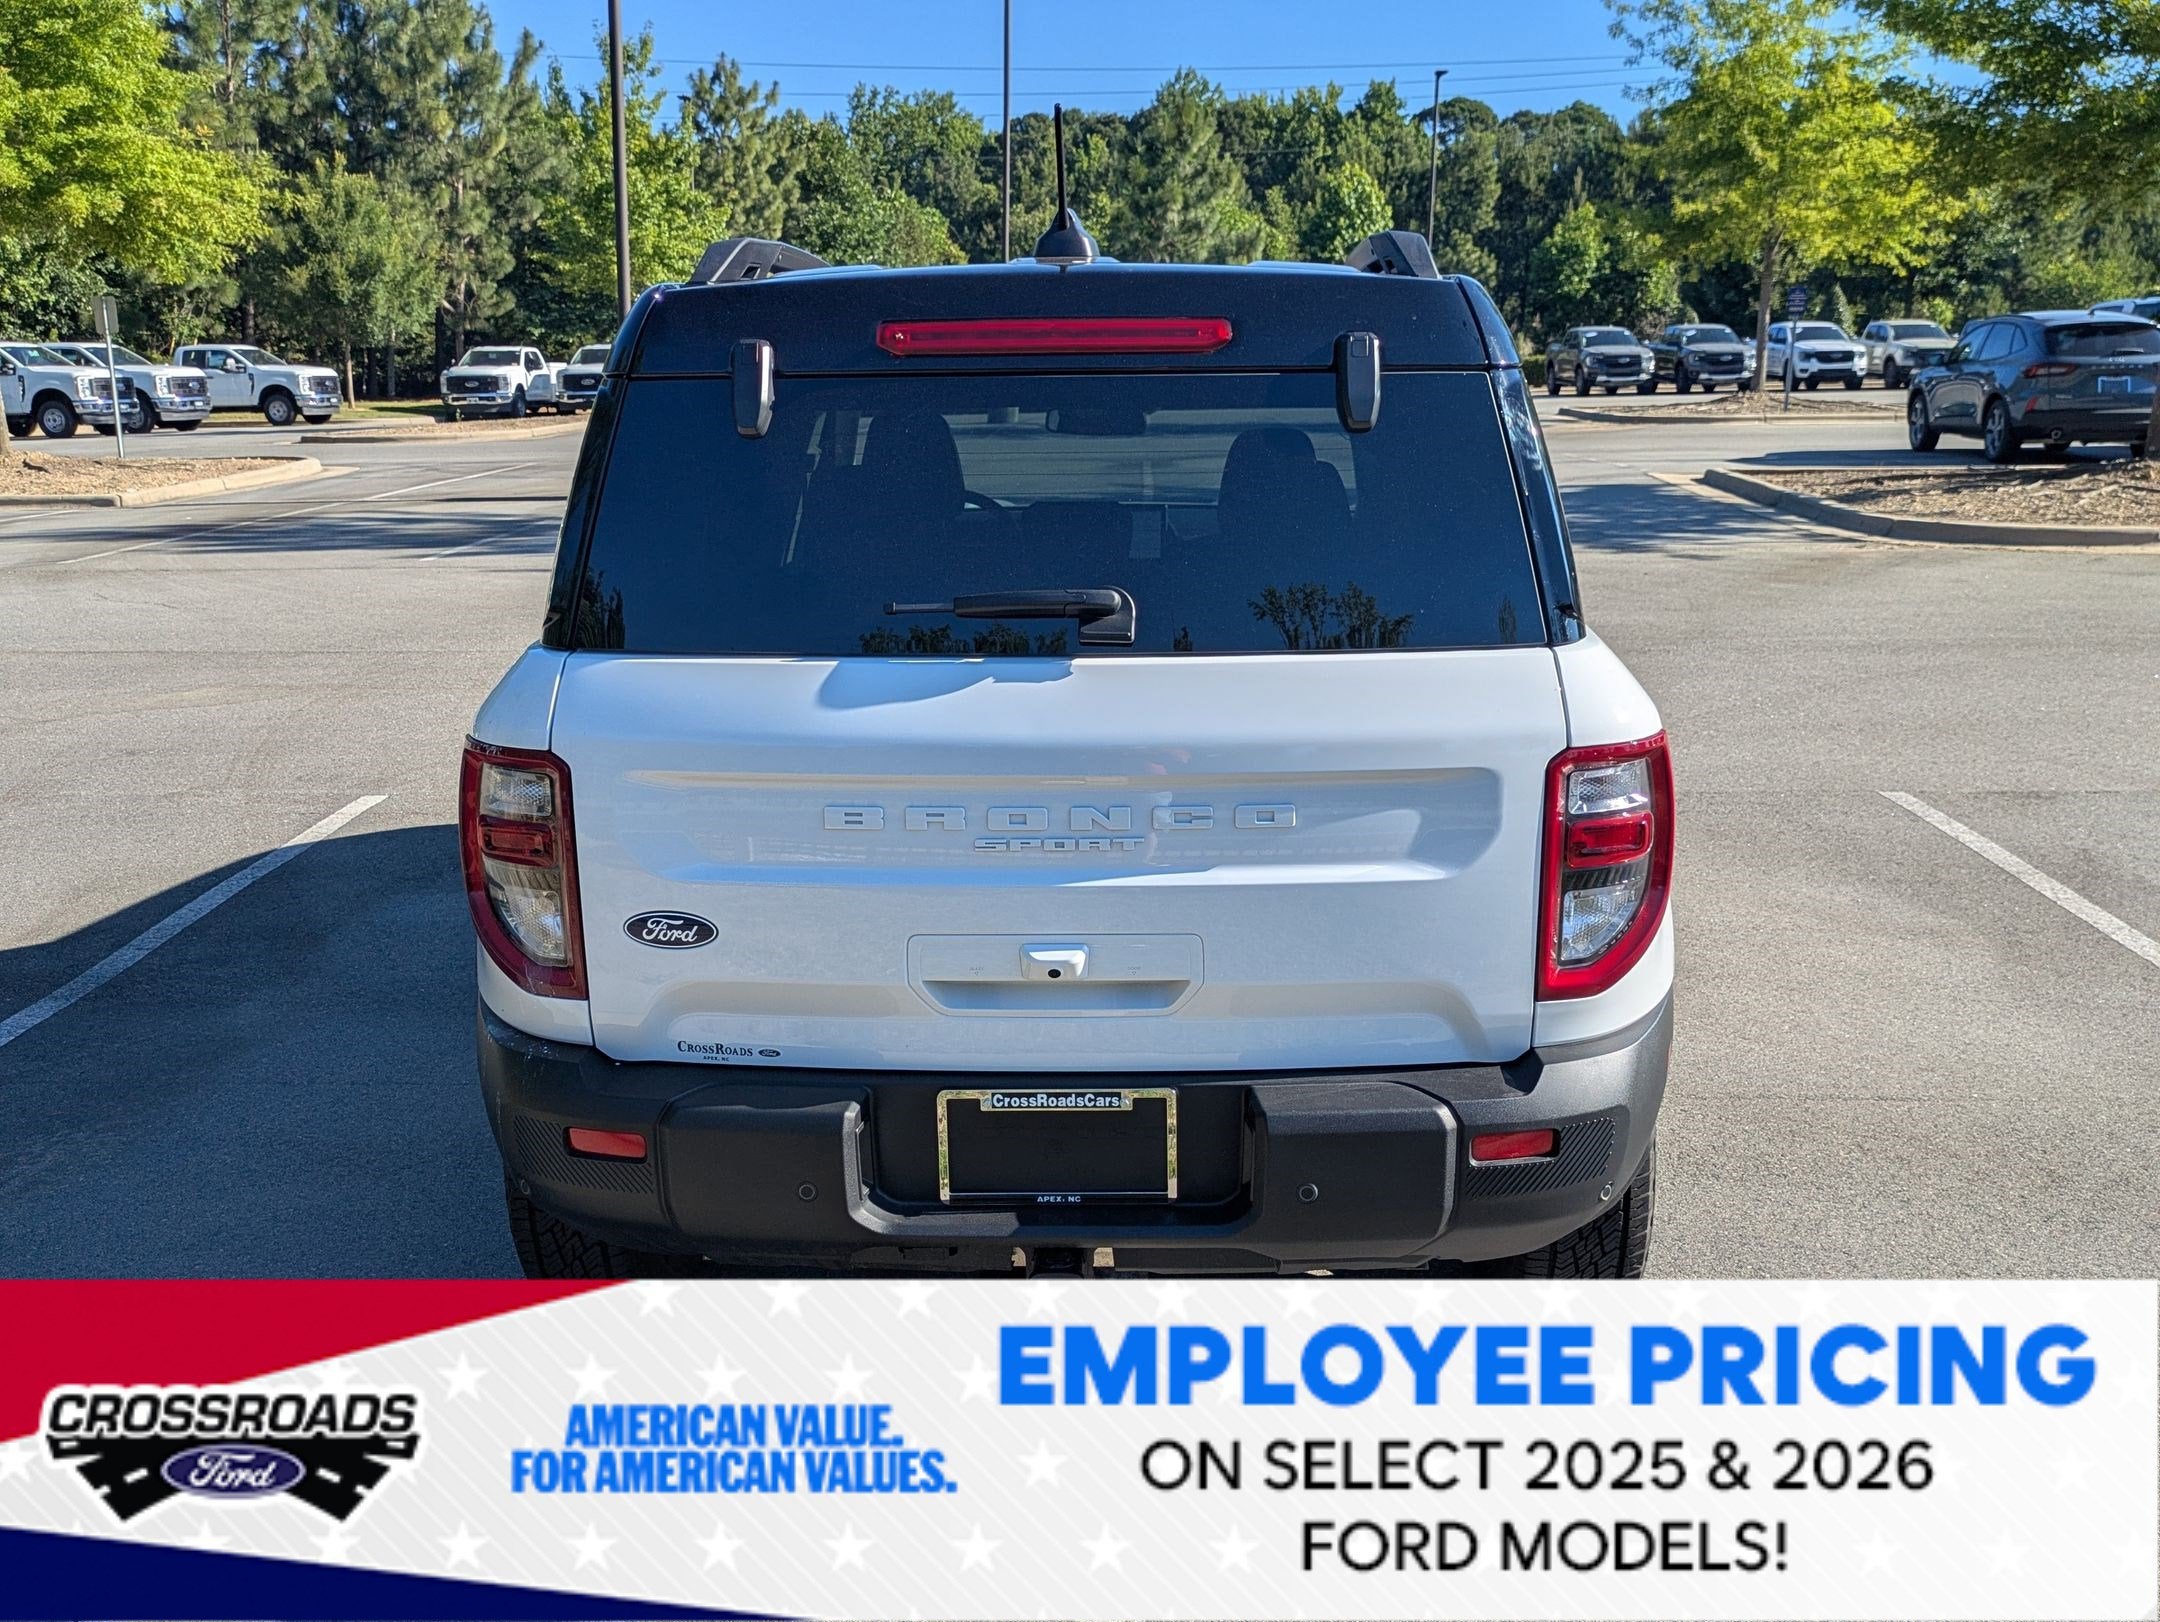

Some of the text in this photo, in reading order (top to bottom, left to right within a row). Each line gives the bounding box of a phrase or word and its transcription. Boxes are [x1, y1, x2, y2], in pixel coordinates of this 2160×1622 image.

[823, 804, 1297, 831] BRONCO
[974, 837, 1145, 852] SPORT
[642, 917, 699, 942] Ford
[992, 1093, 1121, 1108] CrossRoadsCars
[1067, 1195, 1082, 1203] NC
